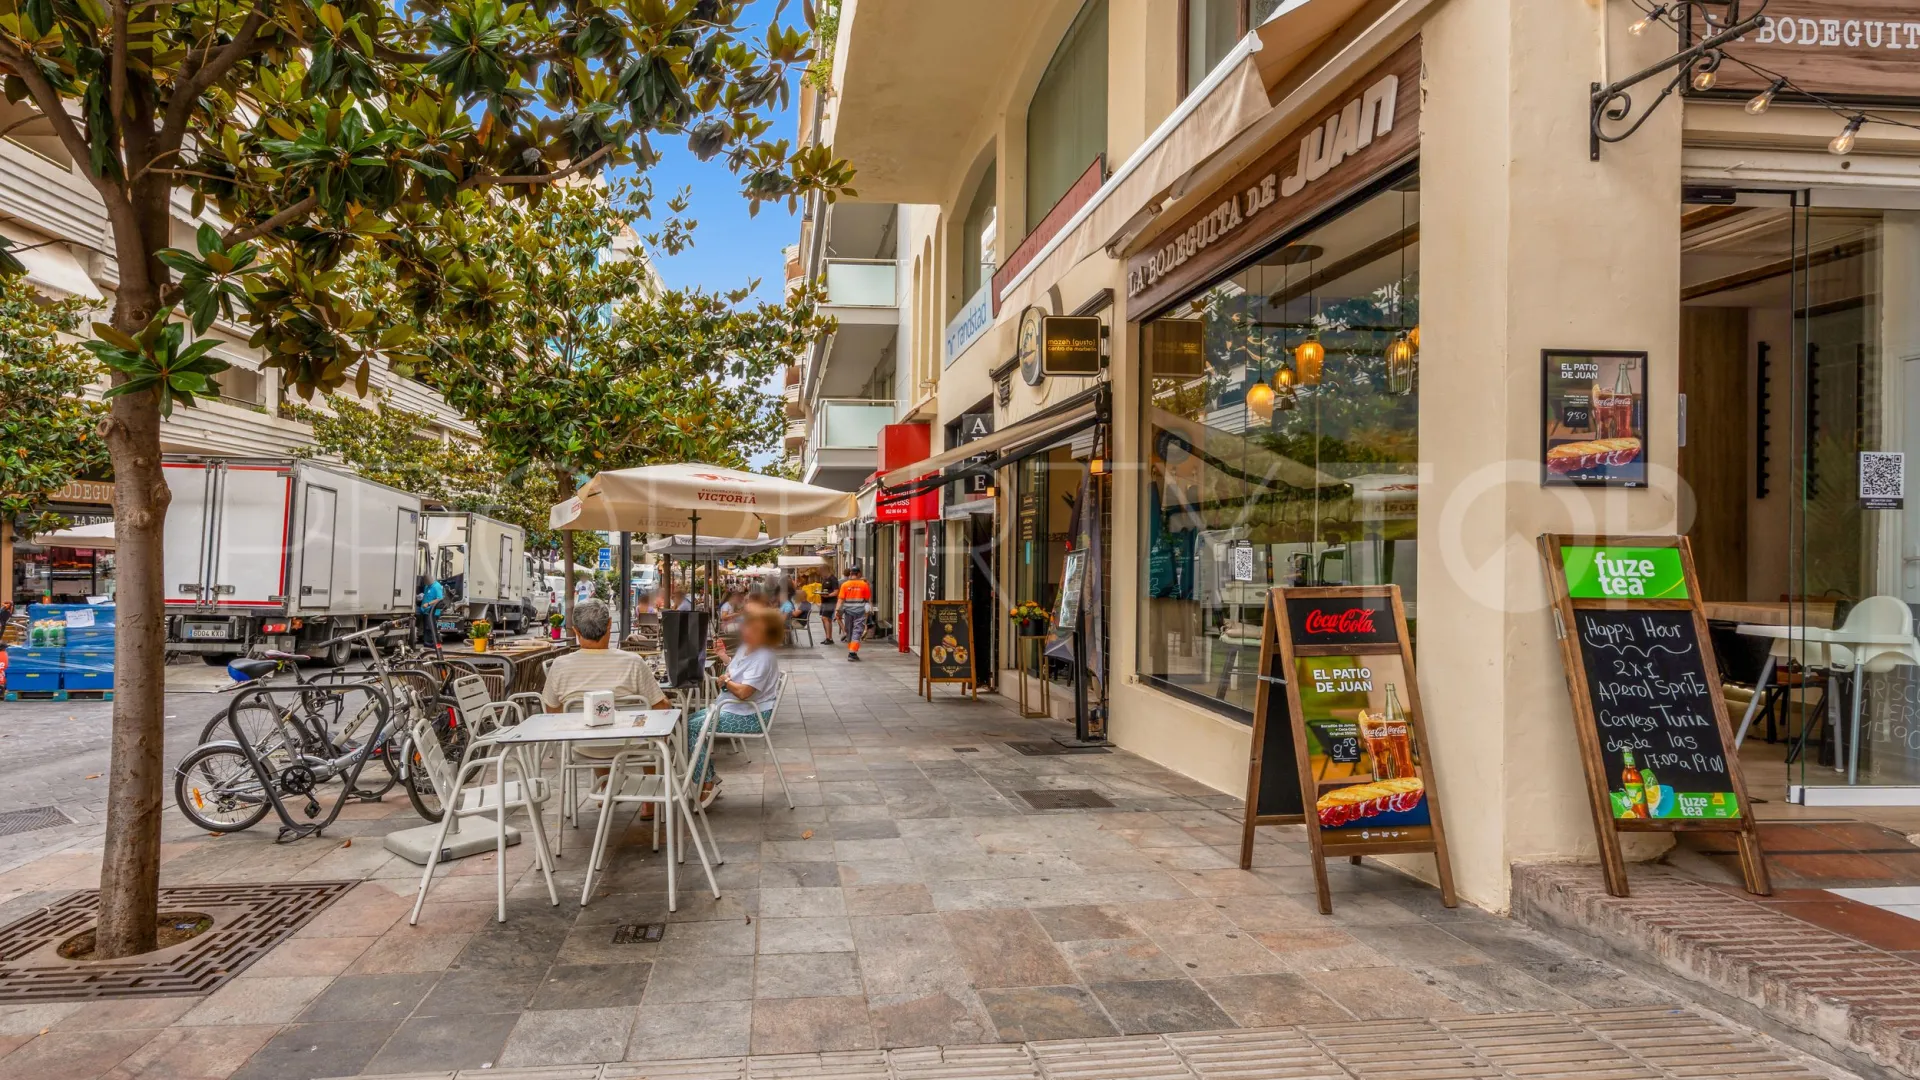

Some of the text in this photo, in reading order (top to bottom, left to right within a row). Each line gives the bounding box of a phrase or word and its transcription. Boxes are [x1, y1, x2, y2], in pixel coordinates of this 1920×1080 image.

[1128, 267, 1148, 298] LA
[1148, 195, 1243, 285] BODEGUITA
[1246, 173, 1276, 217] DE
[1281, 74, 1399, 198] JUAN
[957, 292, 987, 348] randstad
[1561, 363, 1599, 371] EL PATIO
[1561, 371, 1598, 379] DE JUAN
[697, 492, 756, 504] VICTORIA
[73, 515, 86, 526] LA
[1594, 551, 1656, 578] fuze
[1598, 575, 1646, 596] tea
[1305, 608, 1376, 634] Coca-Cola
[1585, 615, 1682, 644] Happy Hour
[1313, 668, 1371, 680] EL PATIO
[1316, 681, 1373, 693] DE JUAN
[1599, 679, 1654, 706] Aperol
[1600, 709, 1658, 732] Cerveza
[1607, 731, 1698, 752] desde las
[1644, 753, 1678, 769] 17:00
[1679, 760, 1691, 770] a
[1678, 793, 1709, 807] fuze
[1680, 805, 1704, 816] tea
